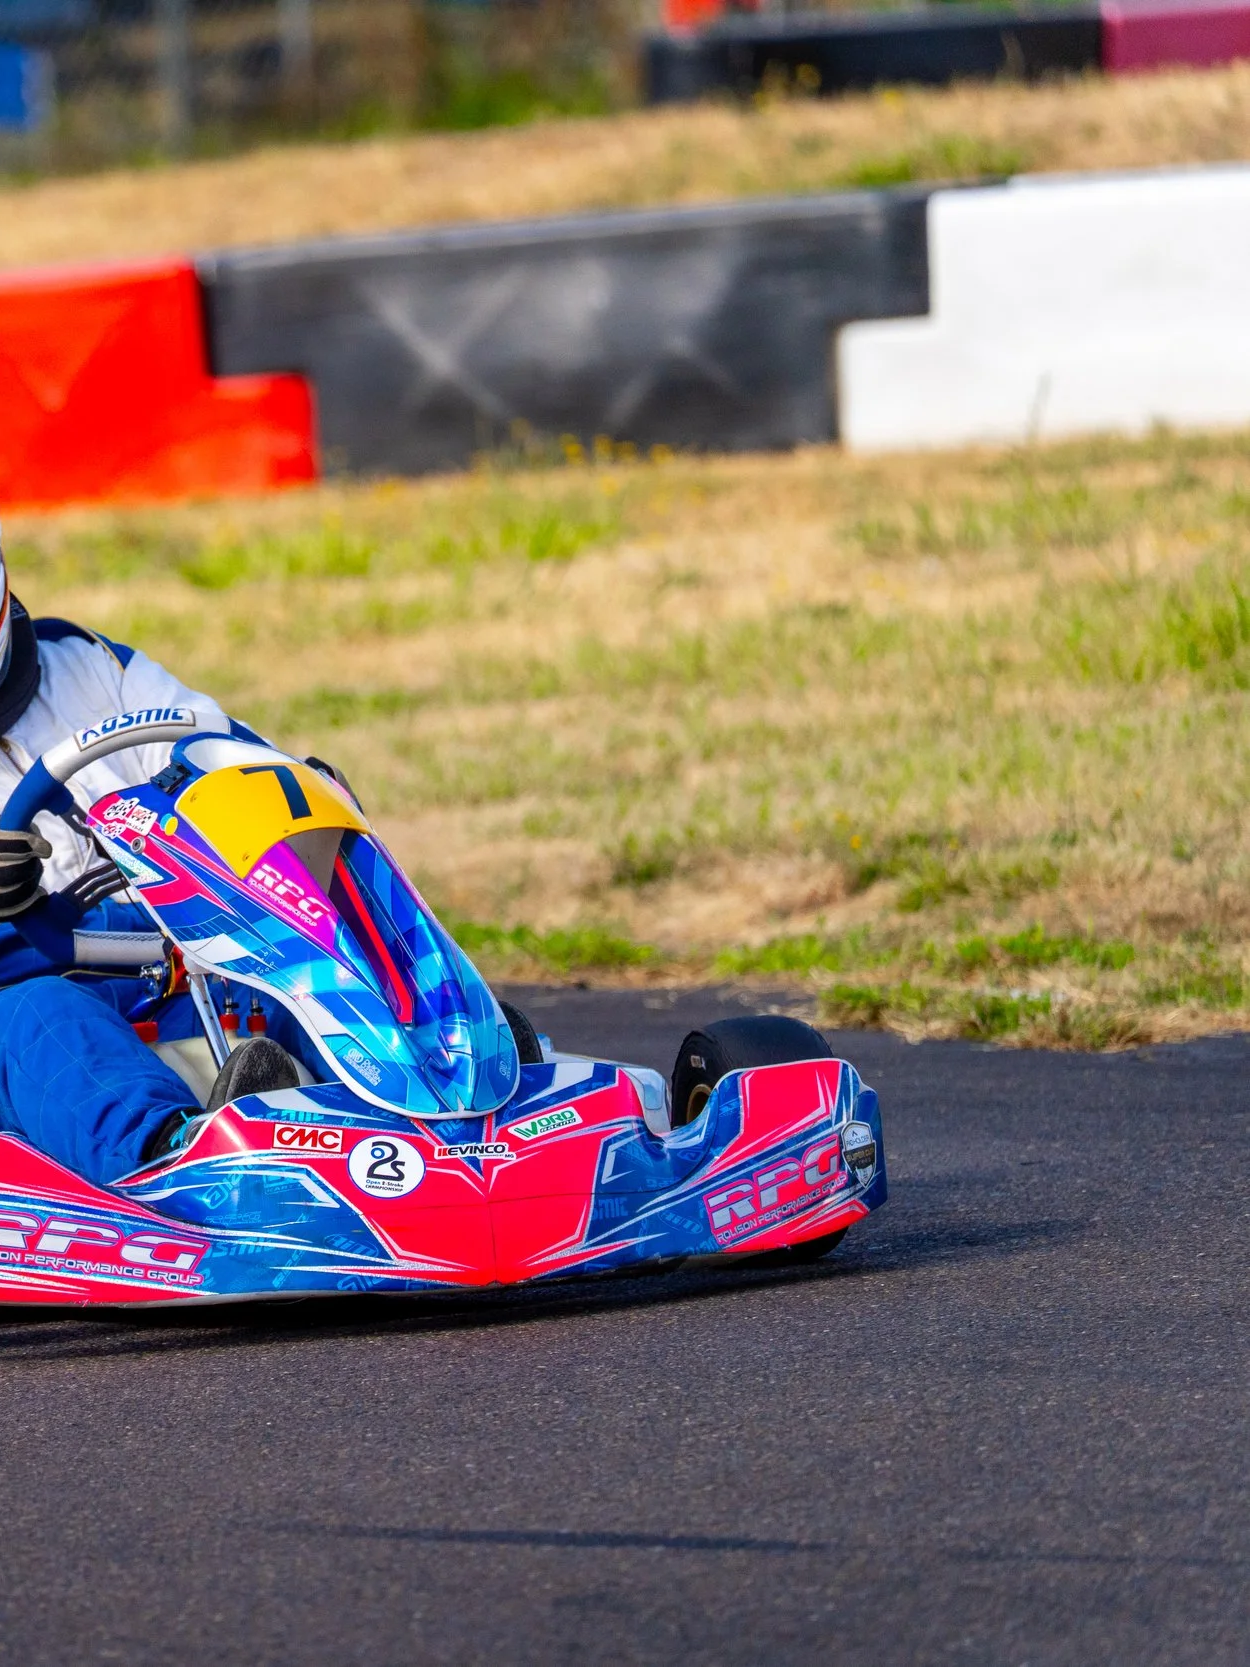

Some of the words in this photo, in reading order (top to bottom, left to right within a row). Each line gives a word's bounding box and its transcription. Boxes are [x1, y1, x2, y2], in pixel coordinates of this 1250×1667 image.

[238, 764, 313, 821] 7
[252, 863, 331, 920] RPG
[276, 1127, 340, 1149] CMC
[707, 1138, 839, 1230] RPG
[716, 1217, 758, 1243] ROLISON
[758, 1187, 822, 1225] PERFORMANCE
[821, 1174, 848, 1195] GROUP
[24, 1254, 146, 1279] PERFORMANCE
[147, 1268, 202, 1285] GROUP
